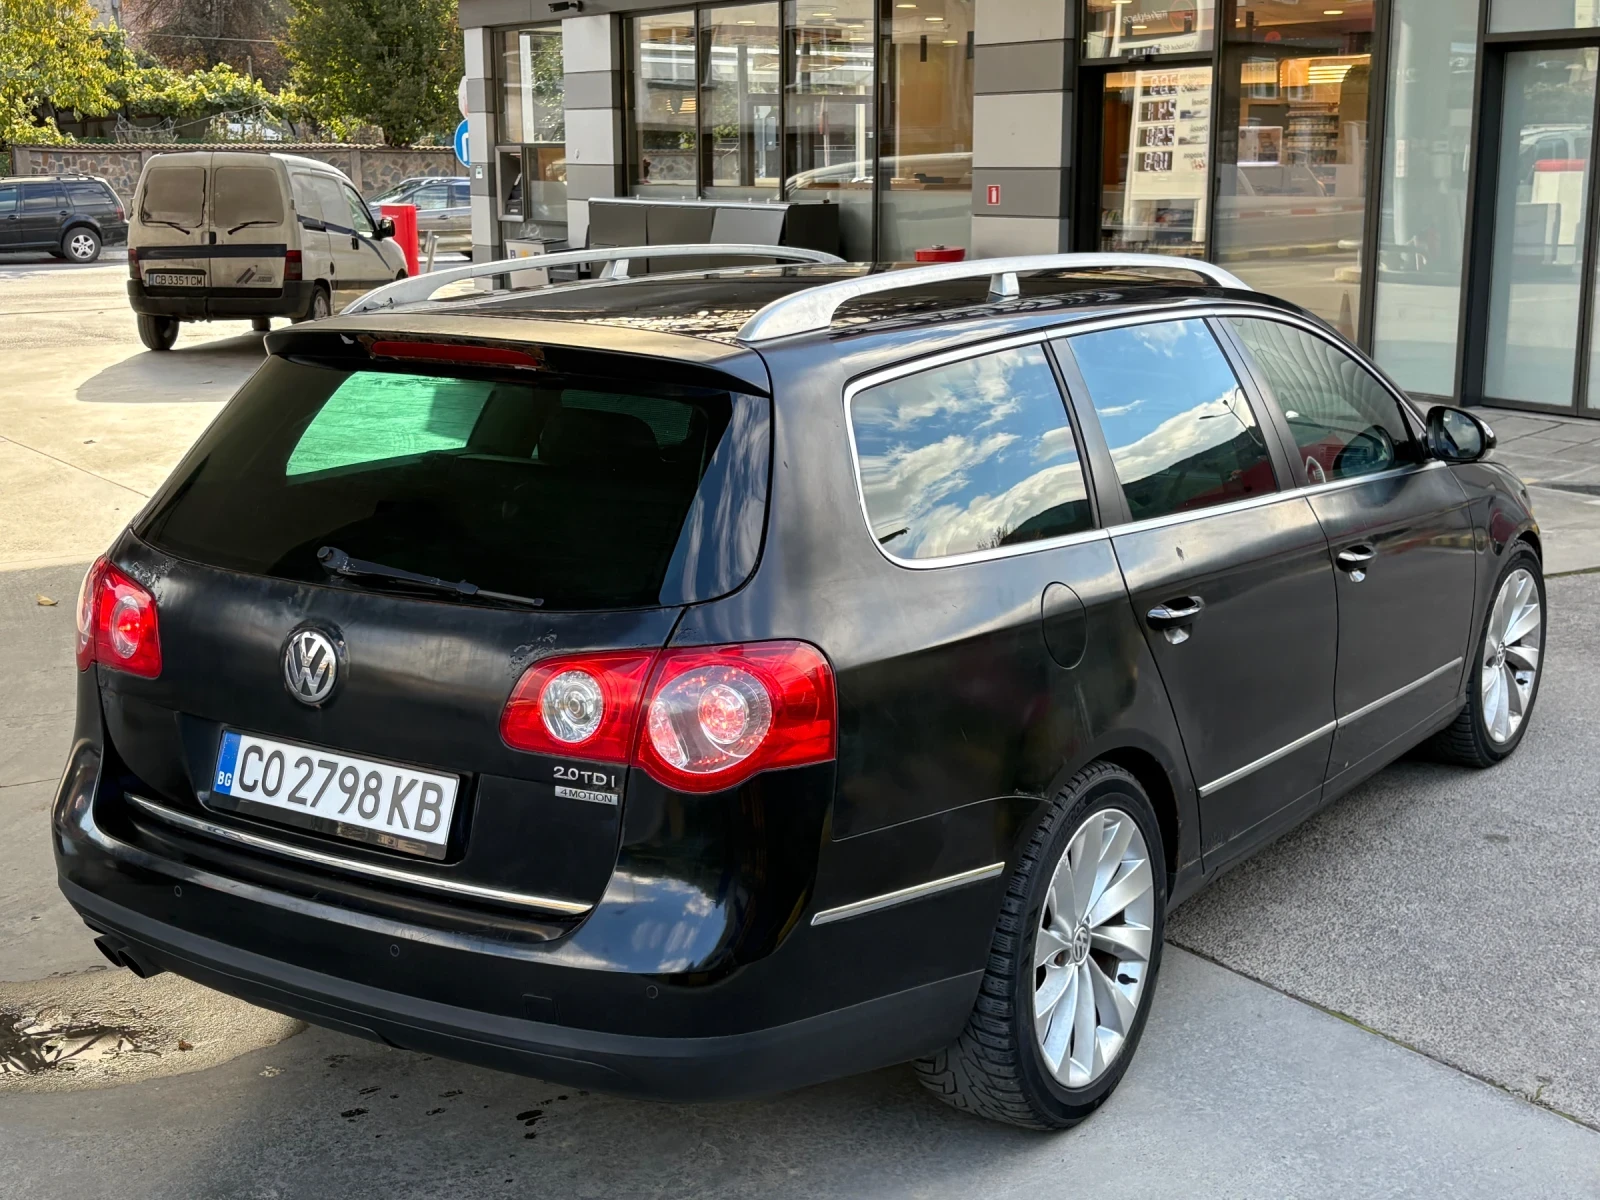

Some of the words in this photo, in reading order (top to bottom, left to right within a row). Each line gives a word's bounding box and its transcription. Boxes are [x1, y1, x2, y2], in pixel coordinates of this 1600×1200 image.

[155, 274, 166, 285] CB
[168, 275, 188, 286] 3351
[190, 276, 203, 286] CM
[217, 770, 233, 787] BG
[287, 756, 383, 820] 2798
[386, 775, 444, 834] KB
[560, 788, 613, 803] 4MOTION
